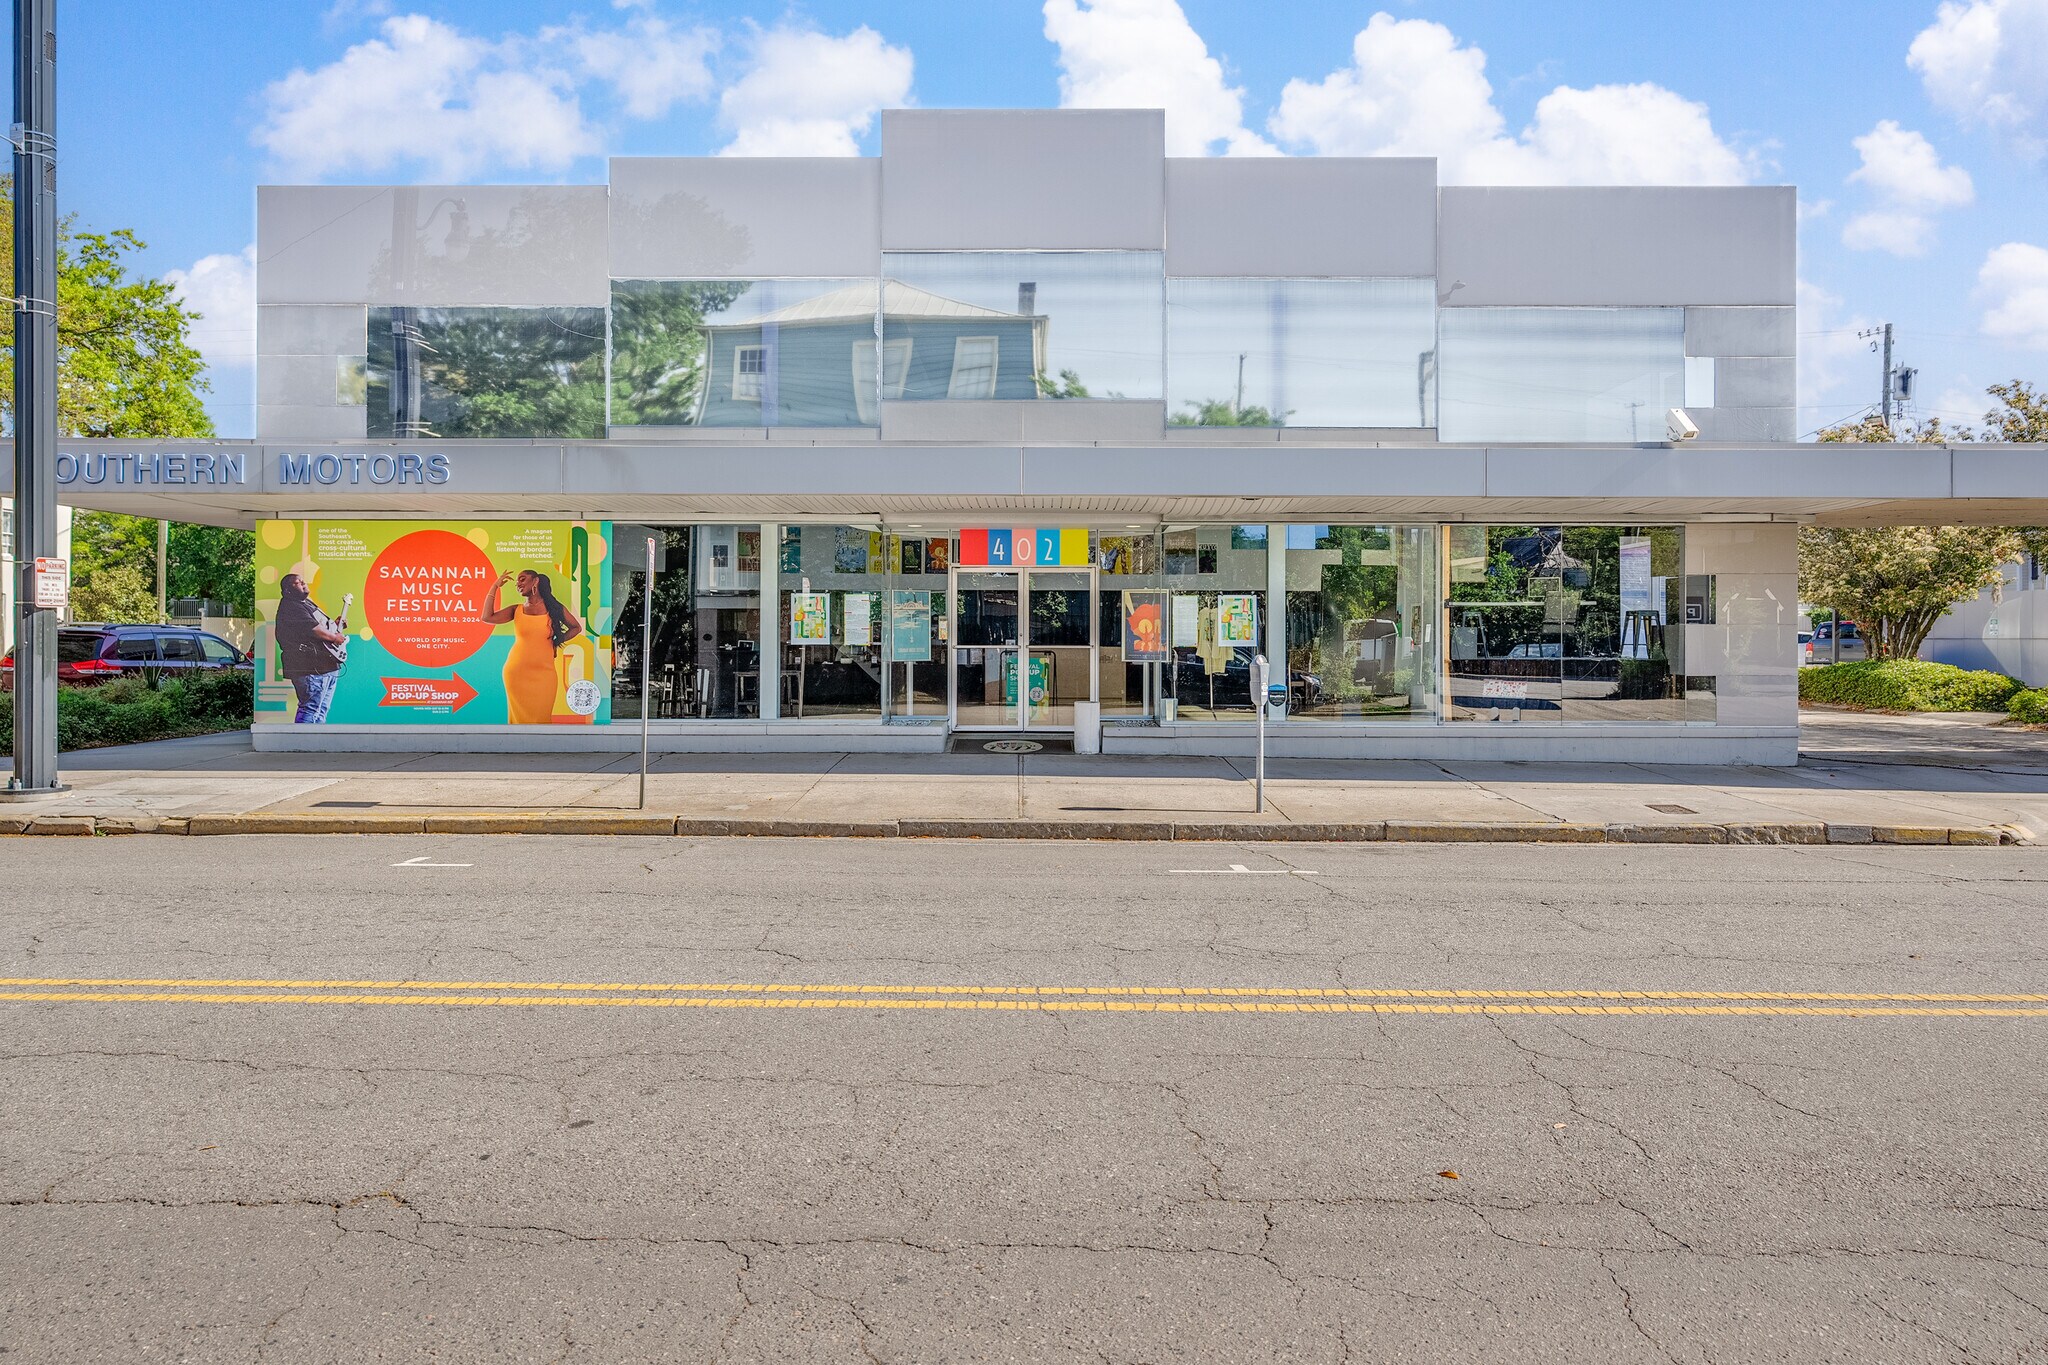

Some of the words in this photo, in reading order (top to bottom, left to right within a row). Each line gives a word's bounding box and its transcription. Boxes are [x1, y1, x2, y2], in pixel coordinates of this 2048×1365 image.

[57, 452, 245, 485] OUTHERN
[279, 452, 451, 485] MOTORS
[993, 537, 1052, 561] 402
[380, 566, 486, 579] SAVANNAH
[402, 582, 463, 595] MUSIC
[387, 599, 478, 612] FESTIVAL
[391, 684, 436, 692] FESTIVAL
[391, 692, 430, 700] POP-UP
[431, 692, 459, 700] SHOP
